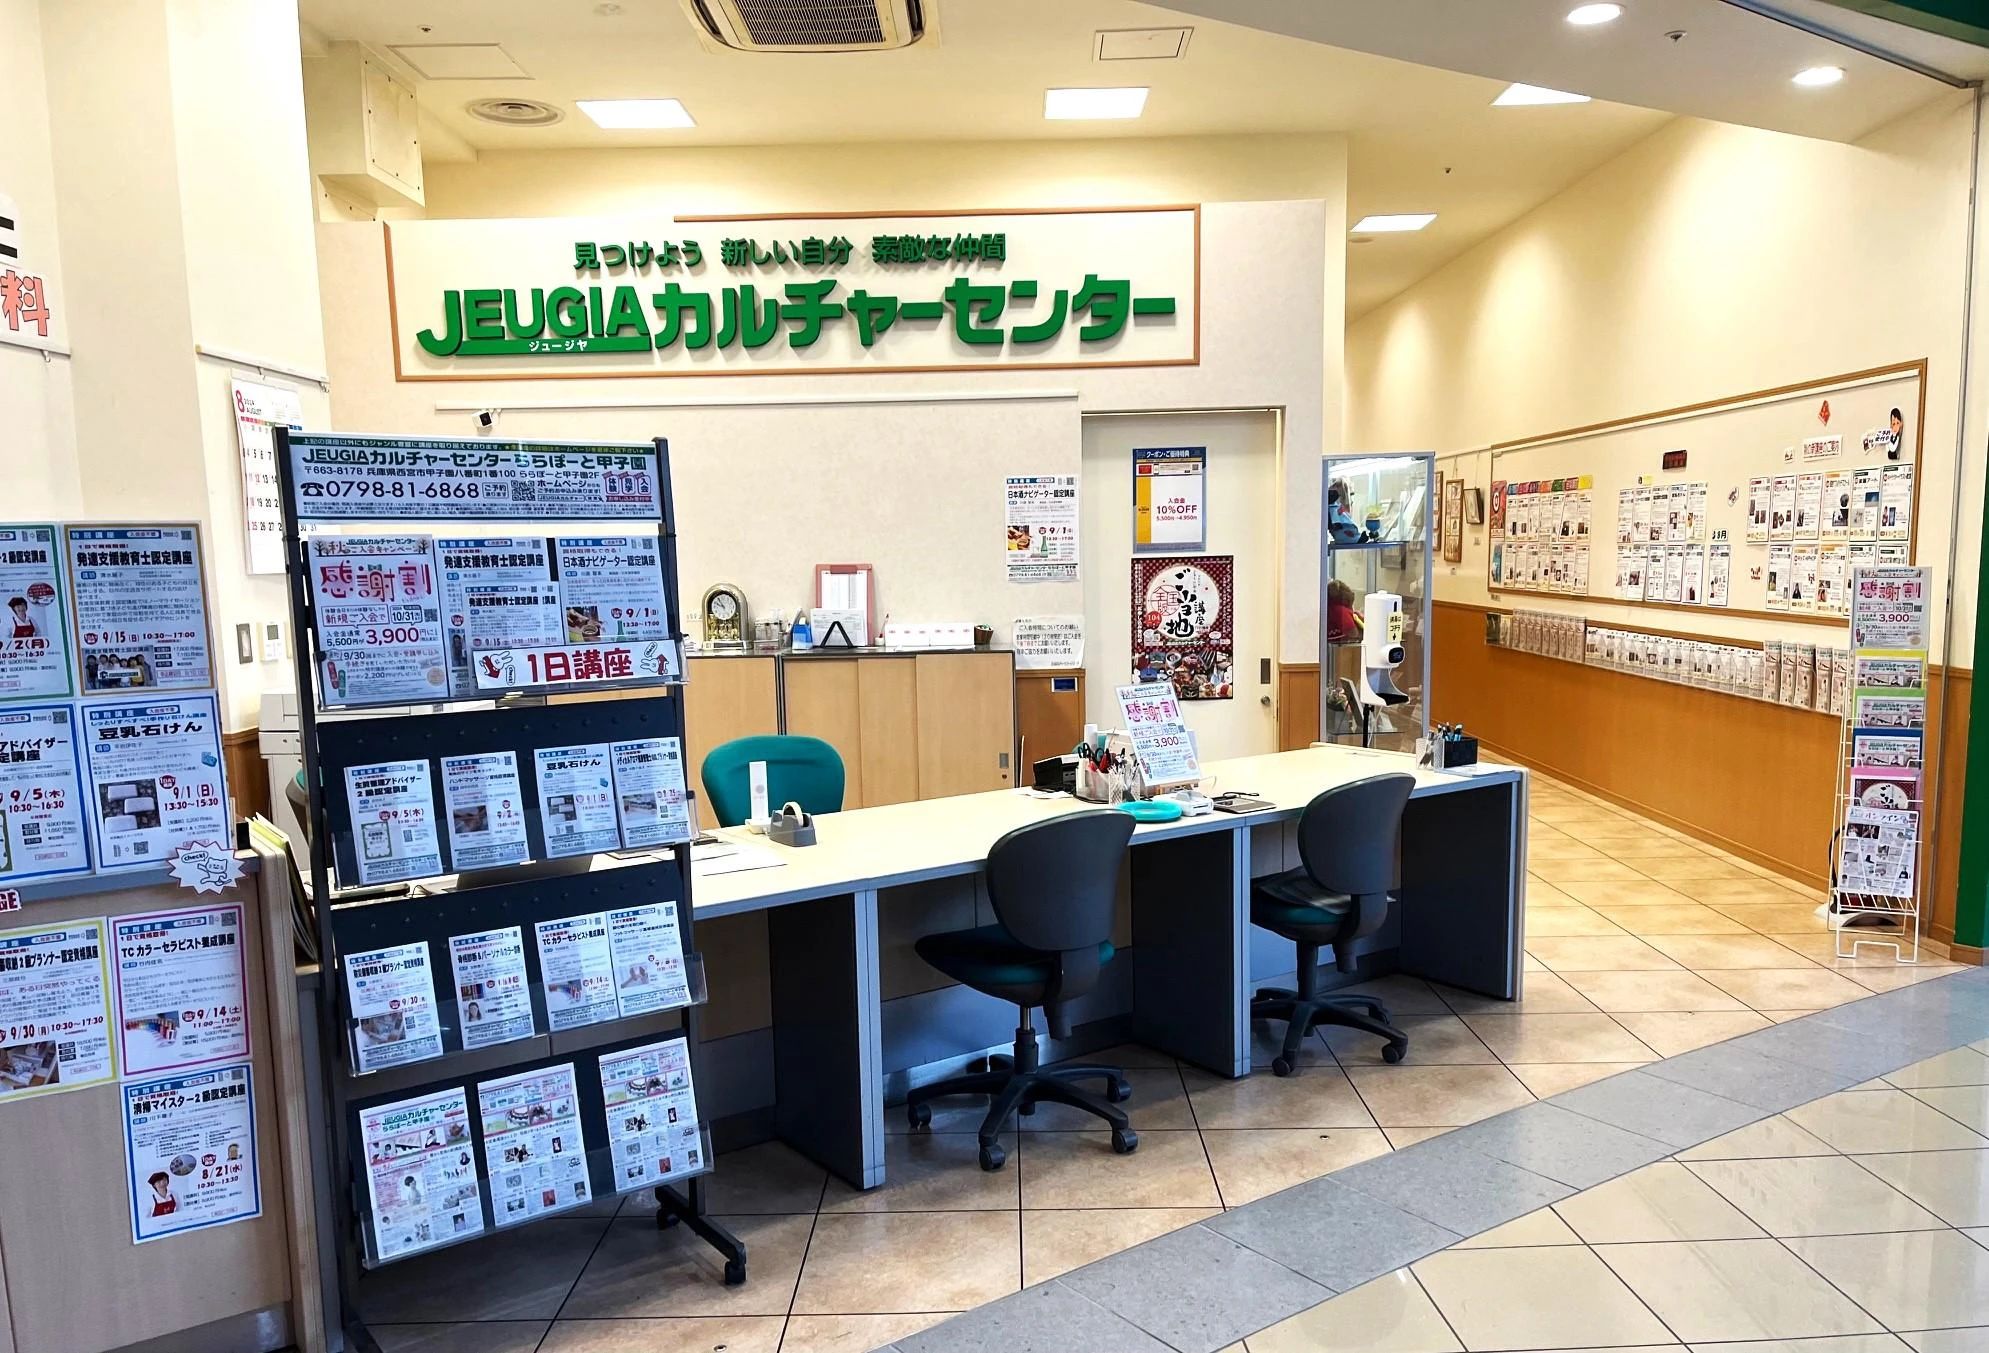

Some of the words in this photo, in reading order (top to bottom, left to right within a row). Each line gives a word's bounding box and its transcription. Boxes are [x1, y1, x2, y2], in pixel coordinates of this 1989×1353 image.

[575, 240, 702, 269] 見つけよう
[721, 236, 852, 268] 新しい自分
[872, 232, 1007, 264] 素敵な仲間
[0, 269, 50, 337] 料
[416, 274, 1176, 356] JEUGIAカルチャーセンター
[235, 390, 245, 413] 8
[326, 480, 480, 498] 0798-81-6868
[537, 479, 587, 488] ホームページ
[624, 478, 634, 493] 見学
[640, 478, 649, 493] 入会
[1156, 505, 1197, 514] 10%OFF
[76, 551, 193, 567] 発達支援教育士認定講座
[444, 554, 545, 569] 発達支援教育士認定講座
[563, 555, 656, 568] 日本酒ナビゲーター認定講座
[319, 560, 432, 602] 感謝割
[392, 610, 415, 621] 10/31
[1878, 613, 1910, 623] 3,900
[102, 631, 126, 643] 9/15
[366, 627, 419, 646] 3,900
[344, 651, 365, 660] 9/30
[527, 648, 634, 683] 1日講座
[98, 721, 203, 741] 豆乳石けん
[1154, 736, 1179, 748] 3,900
[546, 759, 601, 771] 豆乳石けん
[173, 785, 191, 799] 9/1
[197, 1006, 227, 1019] 9/14
[11, 1024, 35, 1041] 9/30
